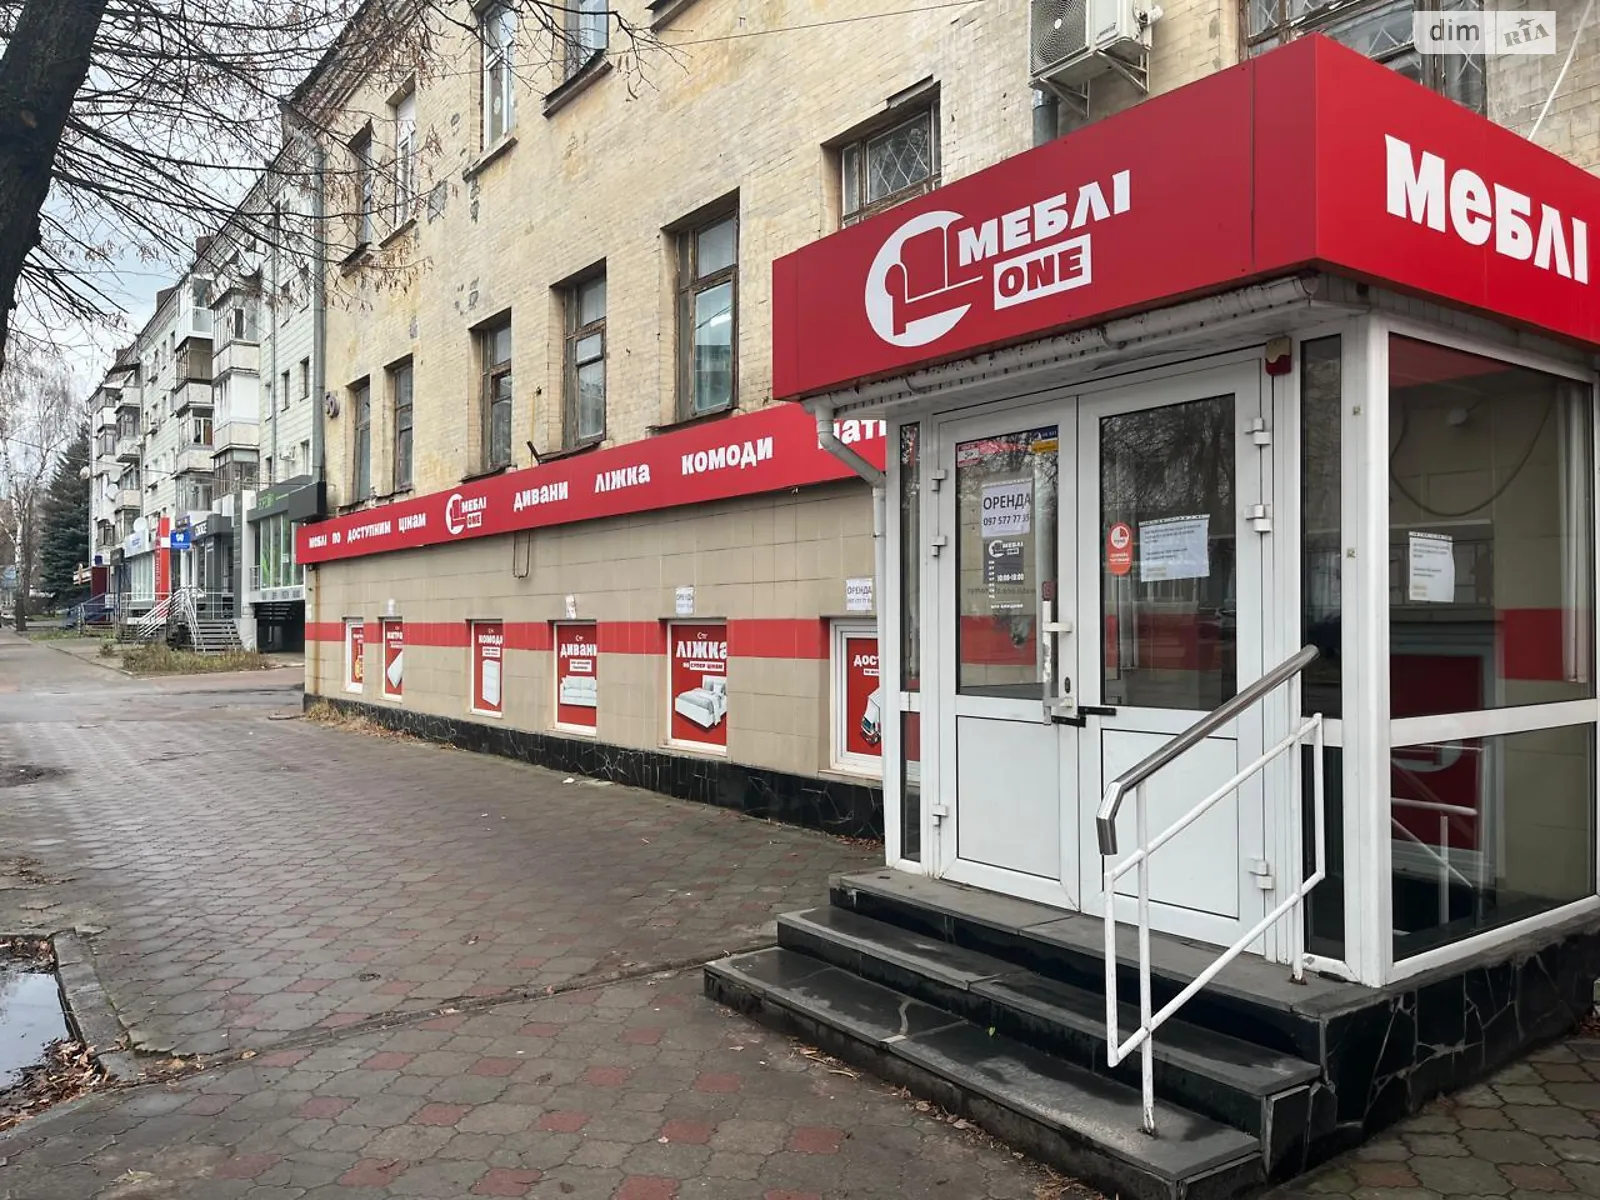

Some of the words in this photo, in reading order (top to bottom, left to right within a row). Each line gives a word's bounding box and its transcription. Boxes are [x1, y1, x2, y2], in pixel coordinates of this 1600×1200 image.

[958, 169, 1130, 267] МЕБЛІ
[998, 245, 1084, 298] ONE
[681, 437, 773, 475] КОМОДИ
[461, 496, 487, 513] МЕБЛІ
[983, 493, 1031, 510] ОРЕНДА
[983, 516, 996, 526] 097
[998, 515, 1010, 525] 577
[1013, 514, 1021, 524] 77
[332, 531, 341, 545] ПО
[347, 520, 391, 544] ДОСТУПНИМ
[847, 585, 872, 595] ОРЕНДА
